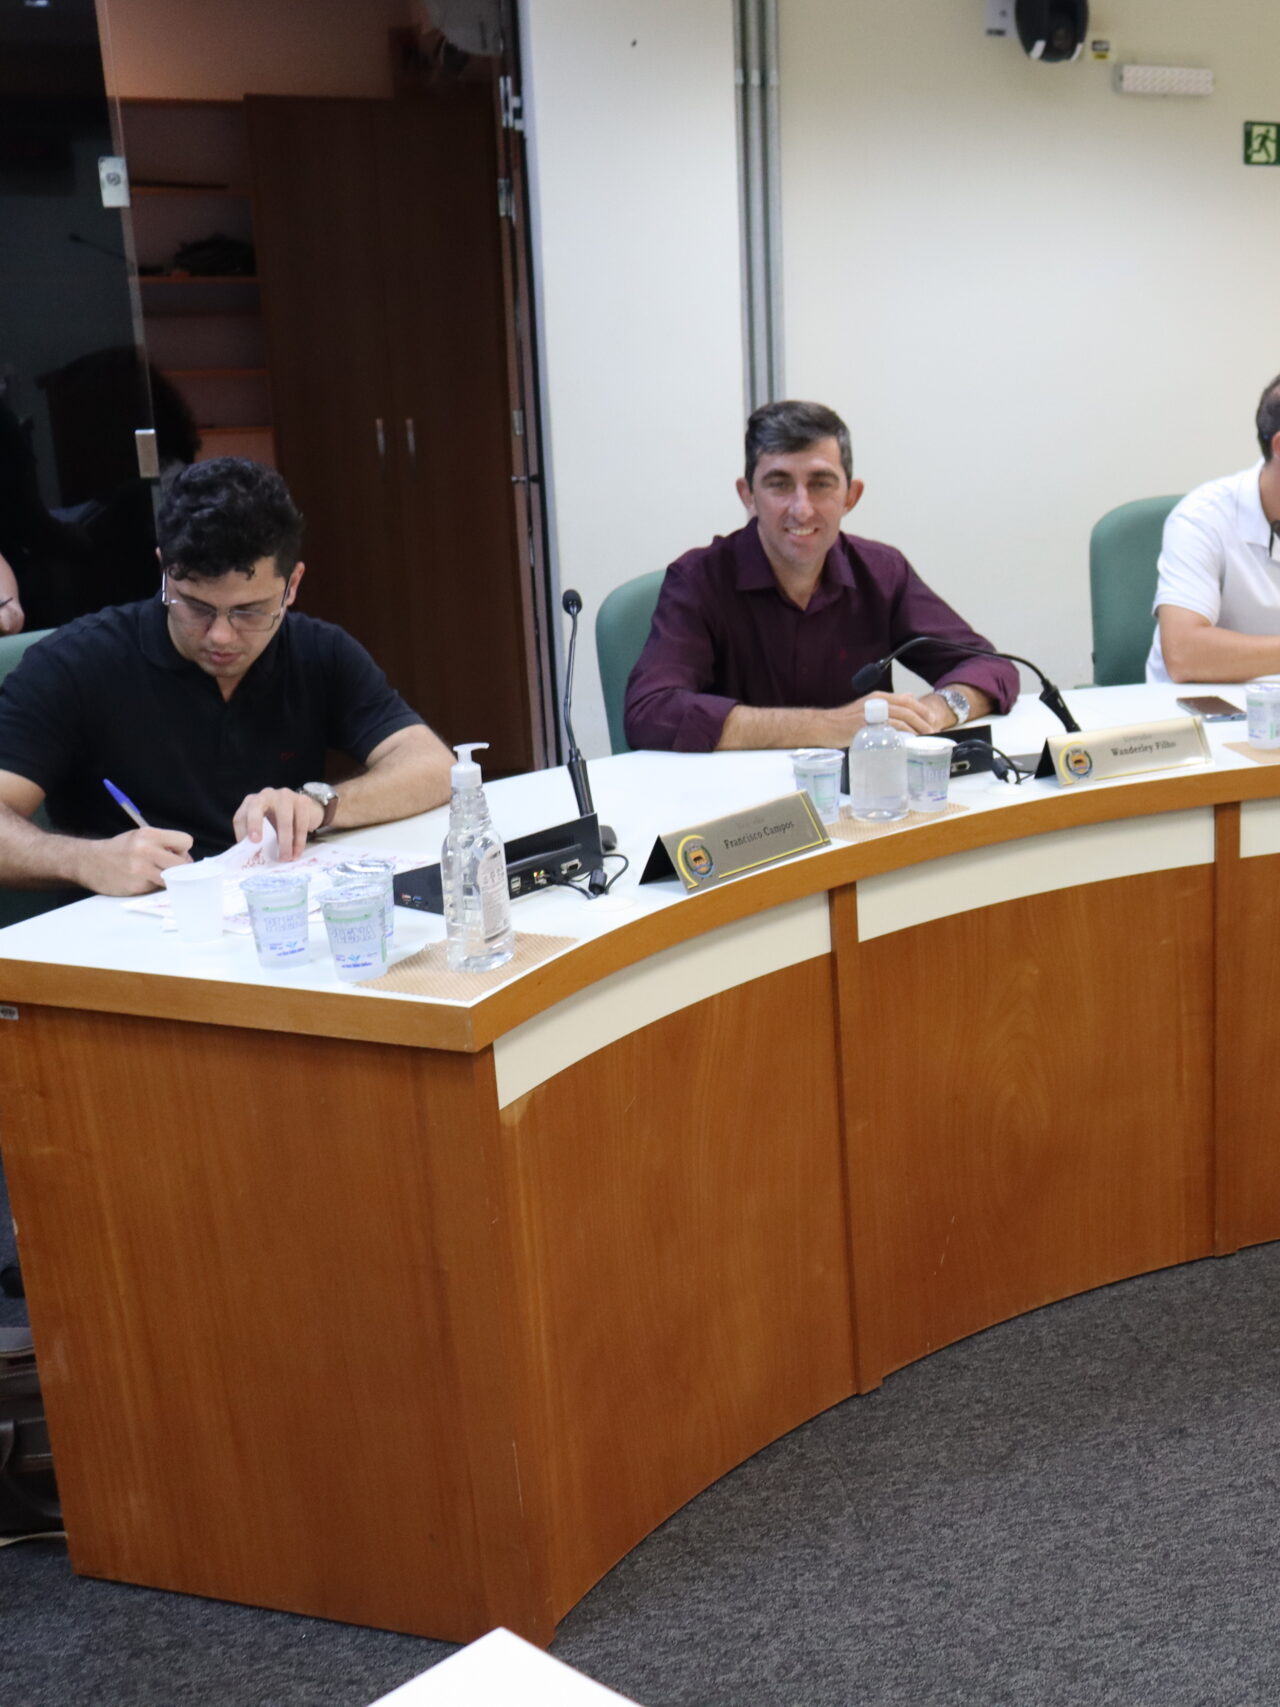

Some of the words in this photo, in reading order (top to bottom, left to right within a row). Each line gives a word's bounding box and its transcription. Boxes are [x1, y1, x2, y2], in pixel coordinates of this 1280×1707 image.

[1110, 743, 1153, 756] Wanderley
[723, 831, 763, 849] Francisco
[763, 820, 795, 837] Campos
